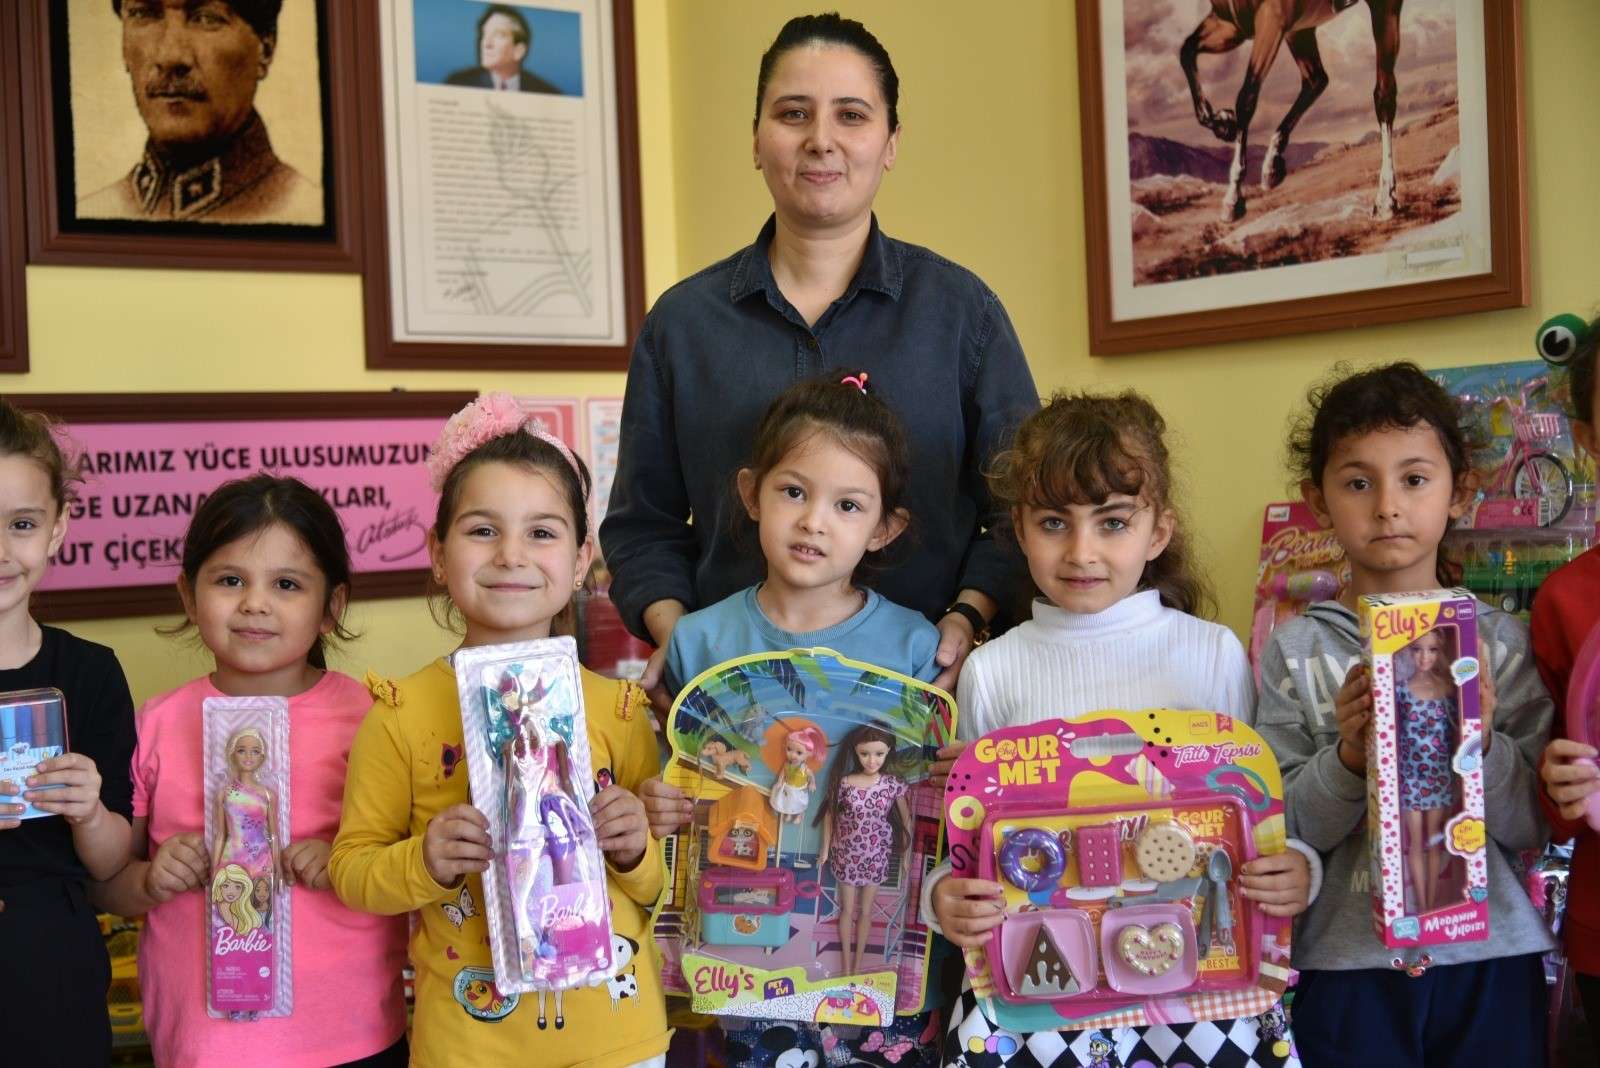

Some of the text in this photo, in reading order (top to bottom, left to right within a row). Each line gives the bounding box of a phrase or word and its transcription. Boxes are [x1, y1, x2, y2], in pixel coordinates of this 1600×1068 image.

[77, 449, 176, 475] ARIMIZ
[184, 441, 250, 471] YÜCE
[113, 492, 206, 519] UZAN
[104, 533, 183, 571] ÇİÇEK
[1374, 607, 1430, 641] Elly's
[998, 758, 1061, 786] MET
[215, 926, 272, 956] Barbie
[1206, 959, 1230, 969] BEST
[694, 966, 755, 998] Elly's
